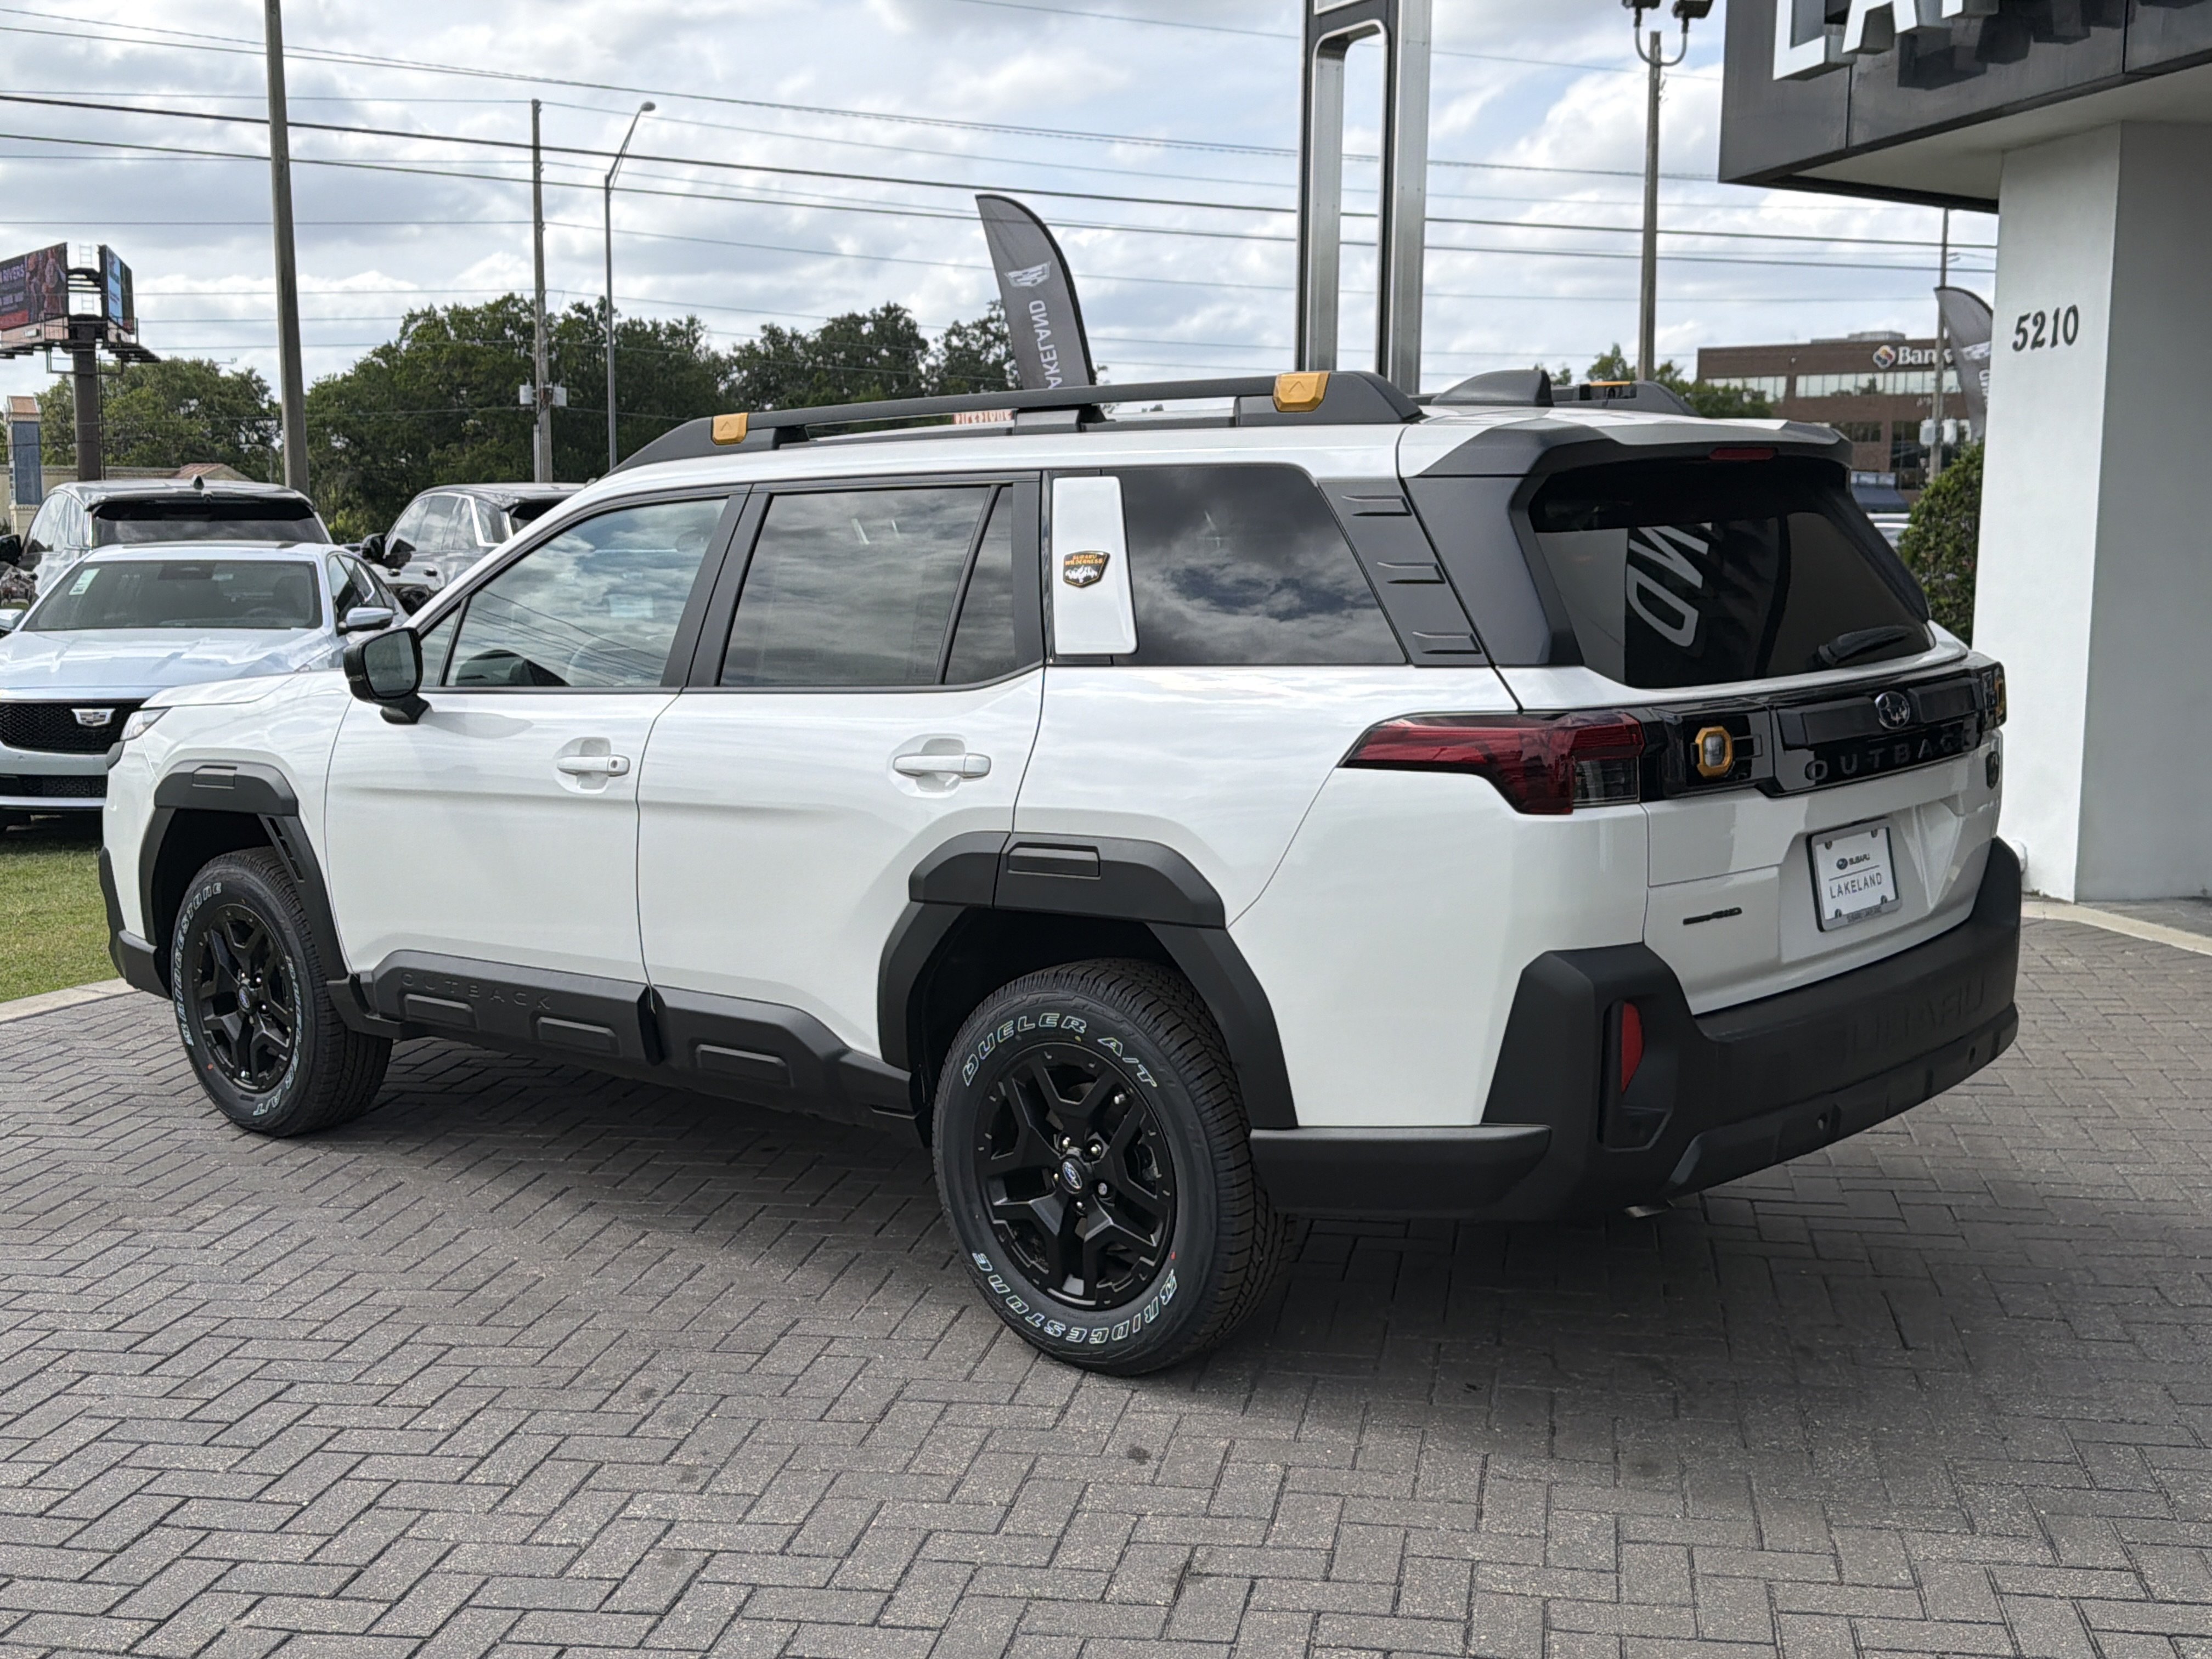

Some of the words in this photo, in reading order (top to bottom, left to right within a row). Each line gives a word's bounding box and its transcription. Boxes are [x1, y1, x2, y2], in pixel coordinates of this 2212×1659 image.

[2012, 304, 2079, 352] 5210
[1804, 727, 1979, 781] OUTBACK
[1829, 872, 1882, 899] LAKELAND
[174, 882, 222, 1046] BRIDGESTONE
[401, 972, 551, 1010] OUTBACK
[962, 1013, 1087, 1087] DUELER
[1097, 1037, 1158, 1088] A/T
[973, 1252, 1177, 1344] BRIDGESTONE
